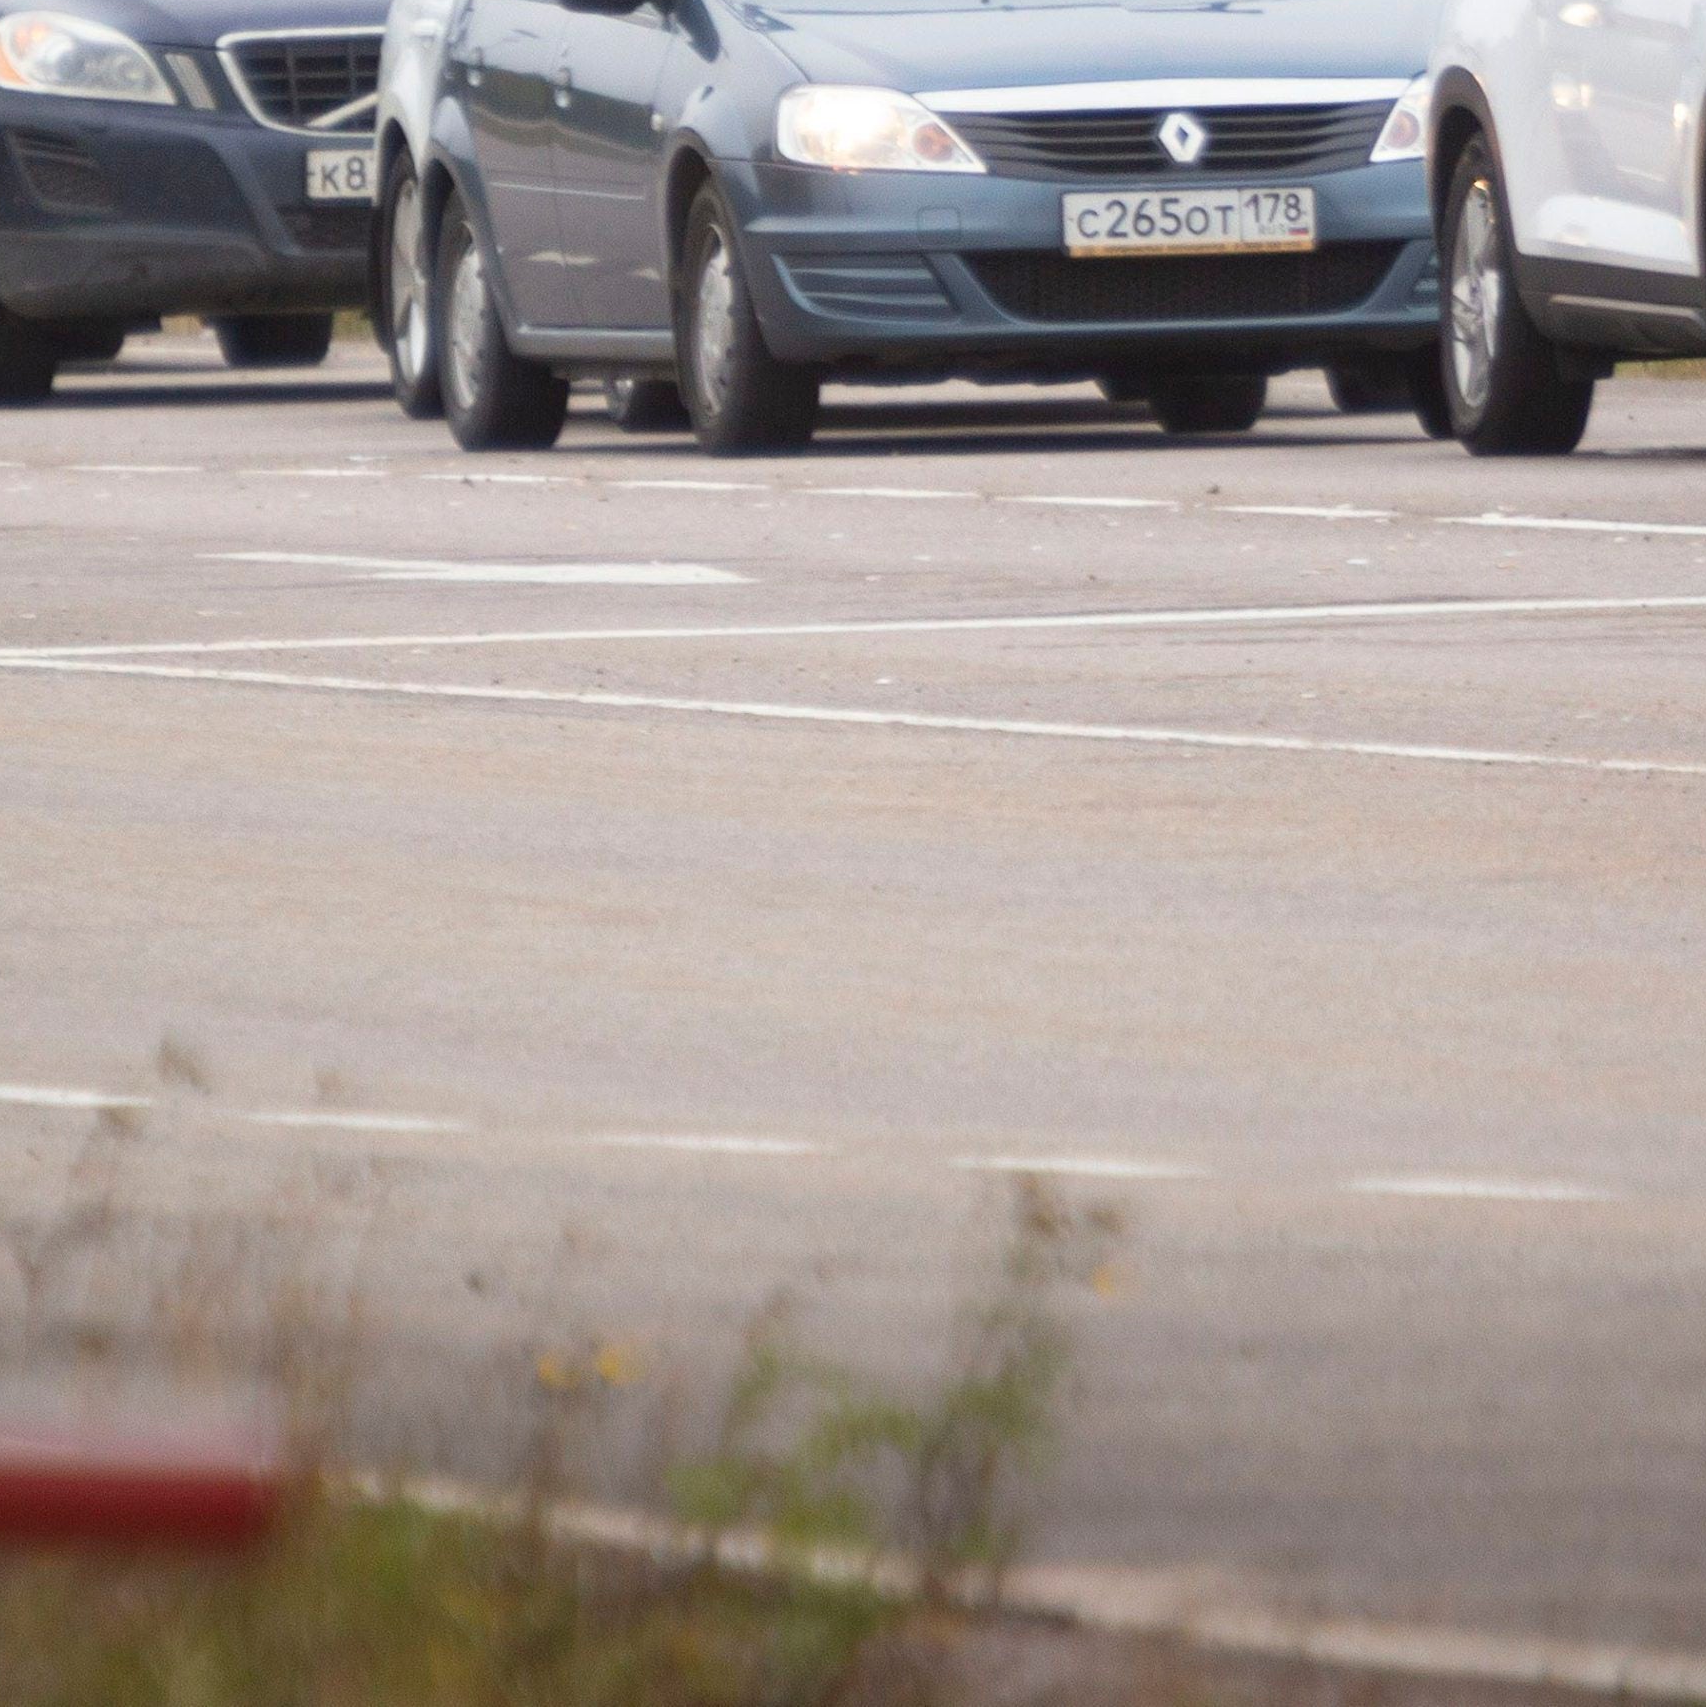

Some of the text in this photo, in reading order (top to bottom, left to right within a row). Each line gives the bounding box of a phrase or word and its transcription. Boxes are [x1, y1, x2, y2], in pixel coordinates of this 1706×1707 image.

[321, 156, 373, 191] К8
[1077, 192, 1302, 239] С265ОТ 178
